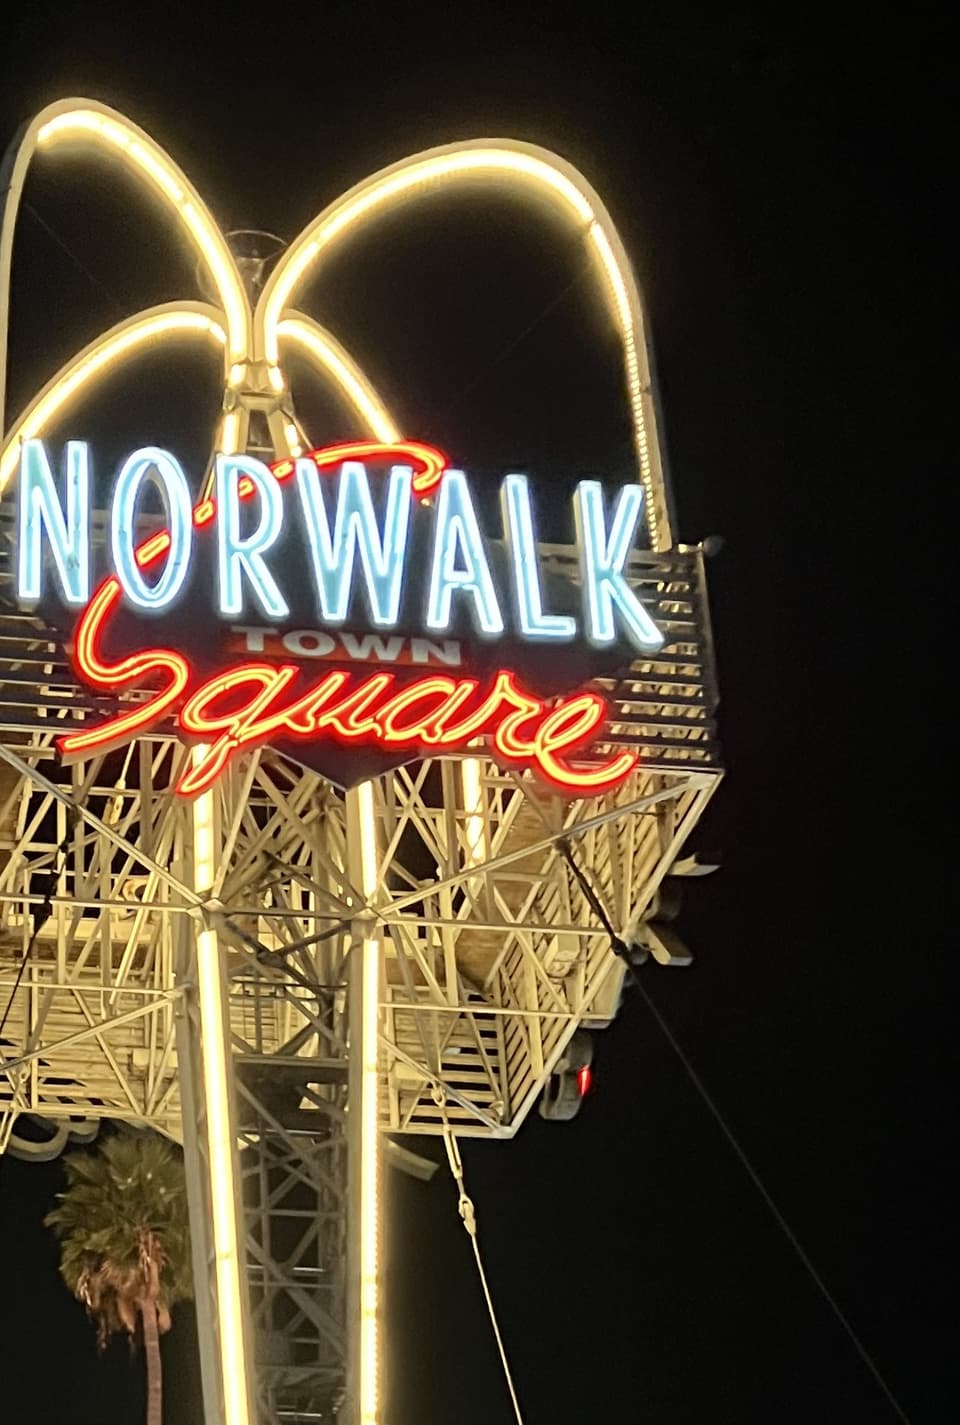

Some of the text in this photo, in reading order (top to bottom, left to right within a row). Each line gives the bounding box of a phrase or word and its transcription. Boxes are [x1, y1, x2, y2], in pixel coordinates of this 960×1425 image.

[16, 440, 665, 651] NORWALK
[56, 440, 638, 796] Square
[231, 625, 461, 666] TOWN
